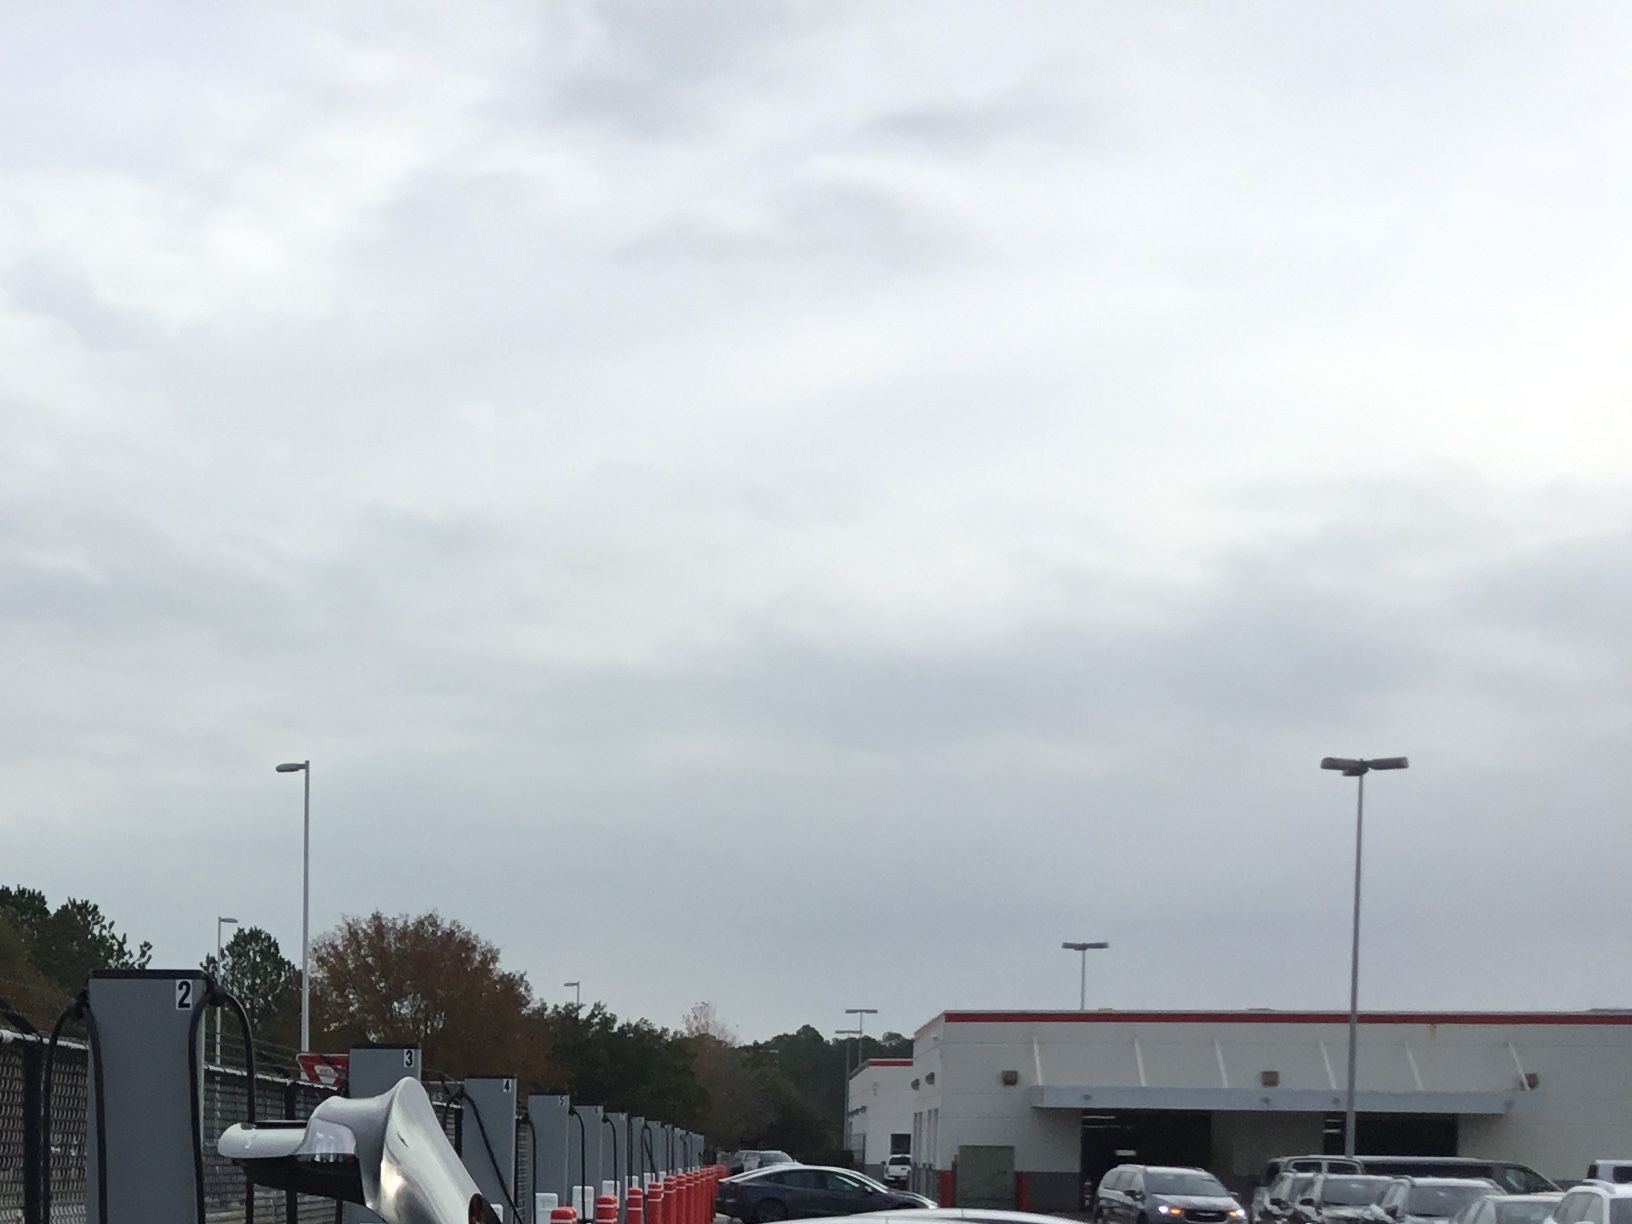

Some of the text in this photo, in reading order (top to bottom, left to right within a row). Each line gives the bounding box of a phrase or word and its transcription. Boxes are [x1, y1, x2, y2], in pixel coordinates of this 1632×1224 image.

[178, 981, 191, 1008] 2
[405, 1050, 413, 1067] 3
[504, 1079, 510, 1092] 4
